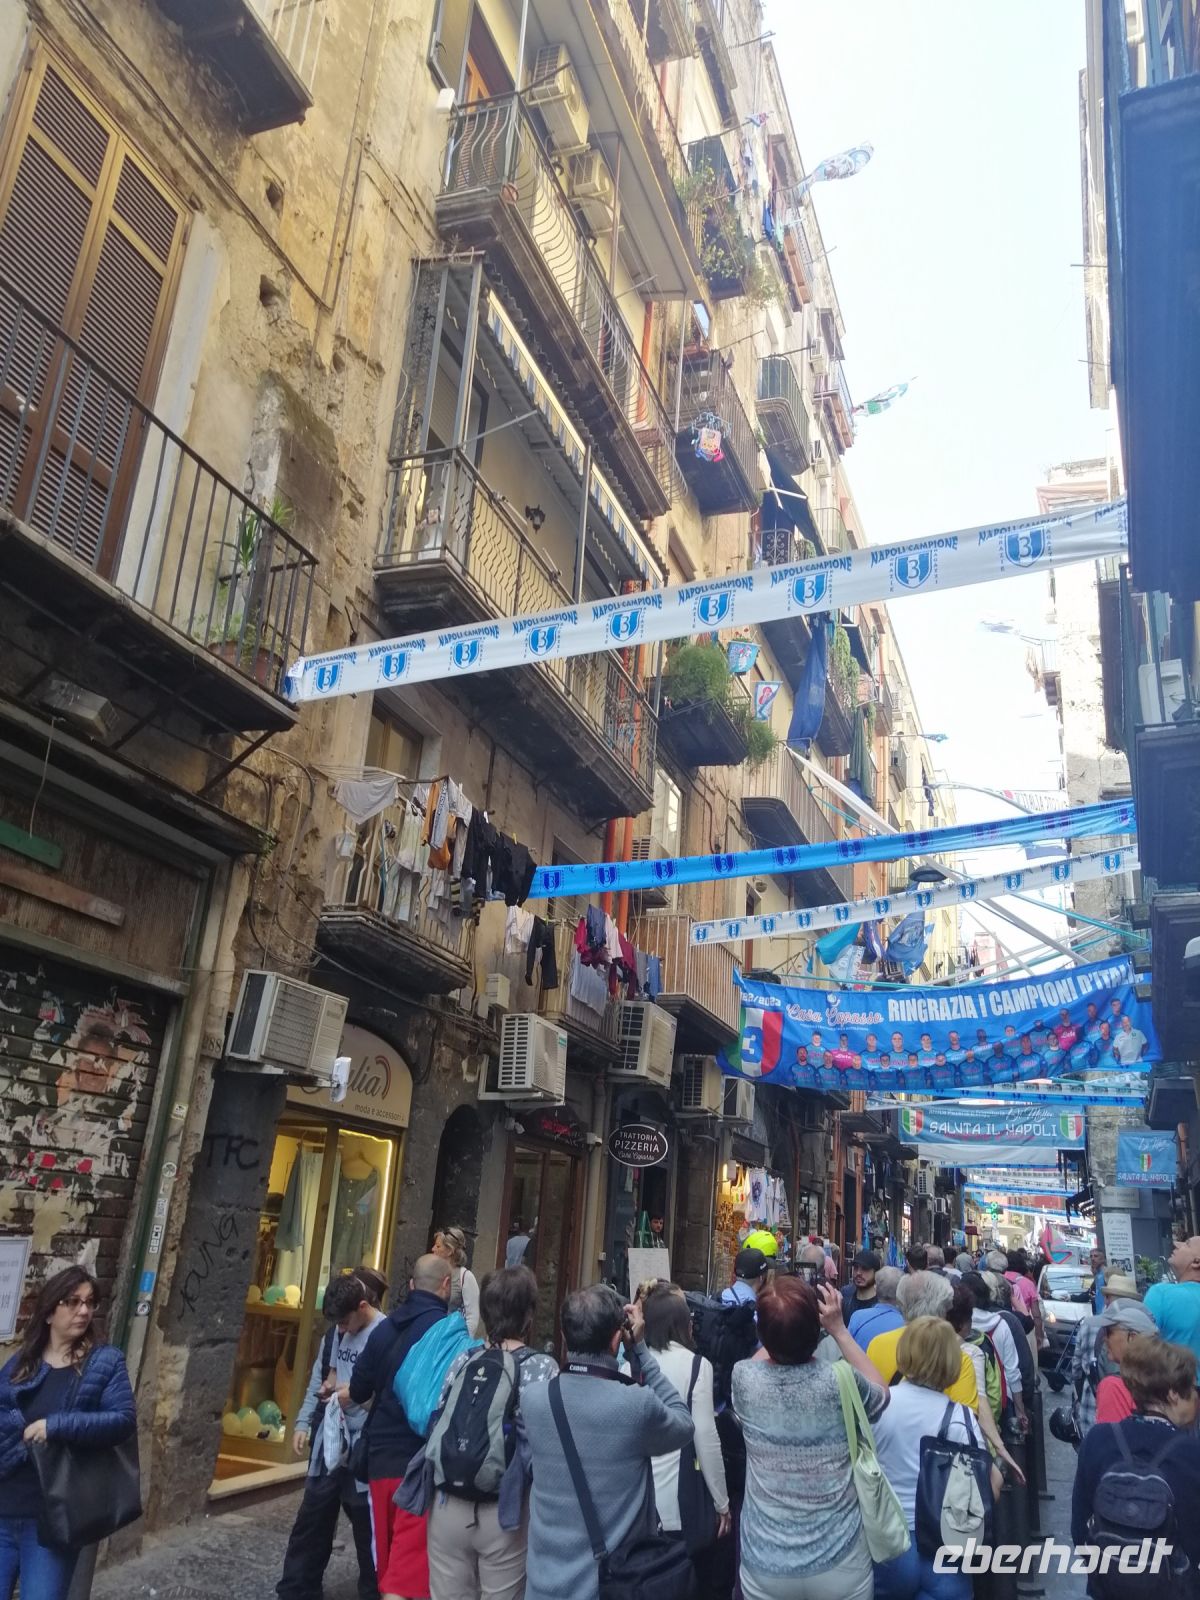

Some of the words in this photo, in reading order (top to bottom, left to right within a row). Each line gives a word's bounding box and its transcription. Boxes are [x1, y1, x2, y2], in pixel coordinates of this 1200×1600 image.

[1019, 536, 1032, 558] 3
[871, 547, 905, 568] NAPOLI
[908, 559, 920, 579] 3
[771, 567, 803, 589] NAPOLI
[678, 585, 708, 606] NAPOLI
[805, 580, 815, 599] 3
[592, 602, 620, 622] NAPOLI
[709, 600, 719, 617] 3
[512, 617, 538, 635] NAPOLI
[621, 616, 629, 633] 3
[438, 631, 462, 648] NAPOLI
[538, 630, 547, 648] 3
[368, 645, 392, 662] NAPOLI
[461, 644, 470, 661] 3
[390, 656, 399, 674] 3
[324, 670, 331, 686] 3
[888, 993, 978, 1023] RINGRAZIA
[978, 993, 989, 1019] I
[990, 976, 1079, 1017] CAMPIONI
[355, 1103, 371, 1116] moda
[620, 1131, 658, 1142] TRATTORIA
[929, 1121, 980, 1135] SALUTA
[986, 1122, 1000, 1135] IL
[1005, 1123, 1058, 1137] NAPOLI
[615, 1139, 660, 1153] PIZZERIA
[569, 1364, 588, 1372] Canon
